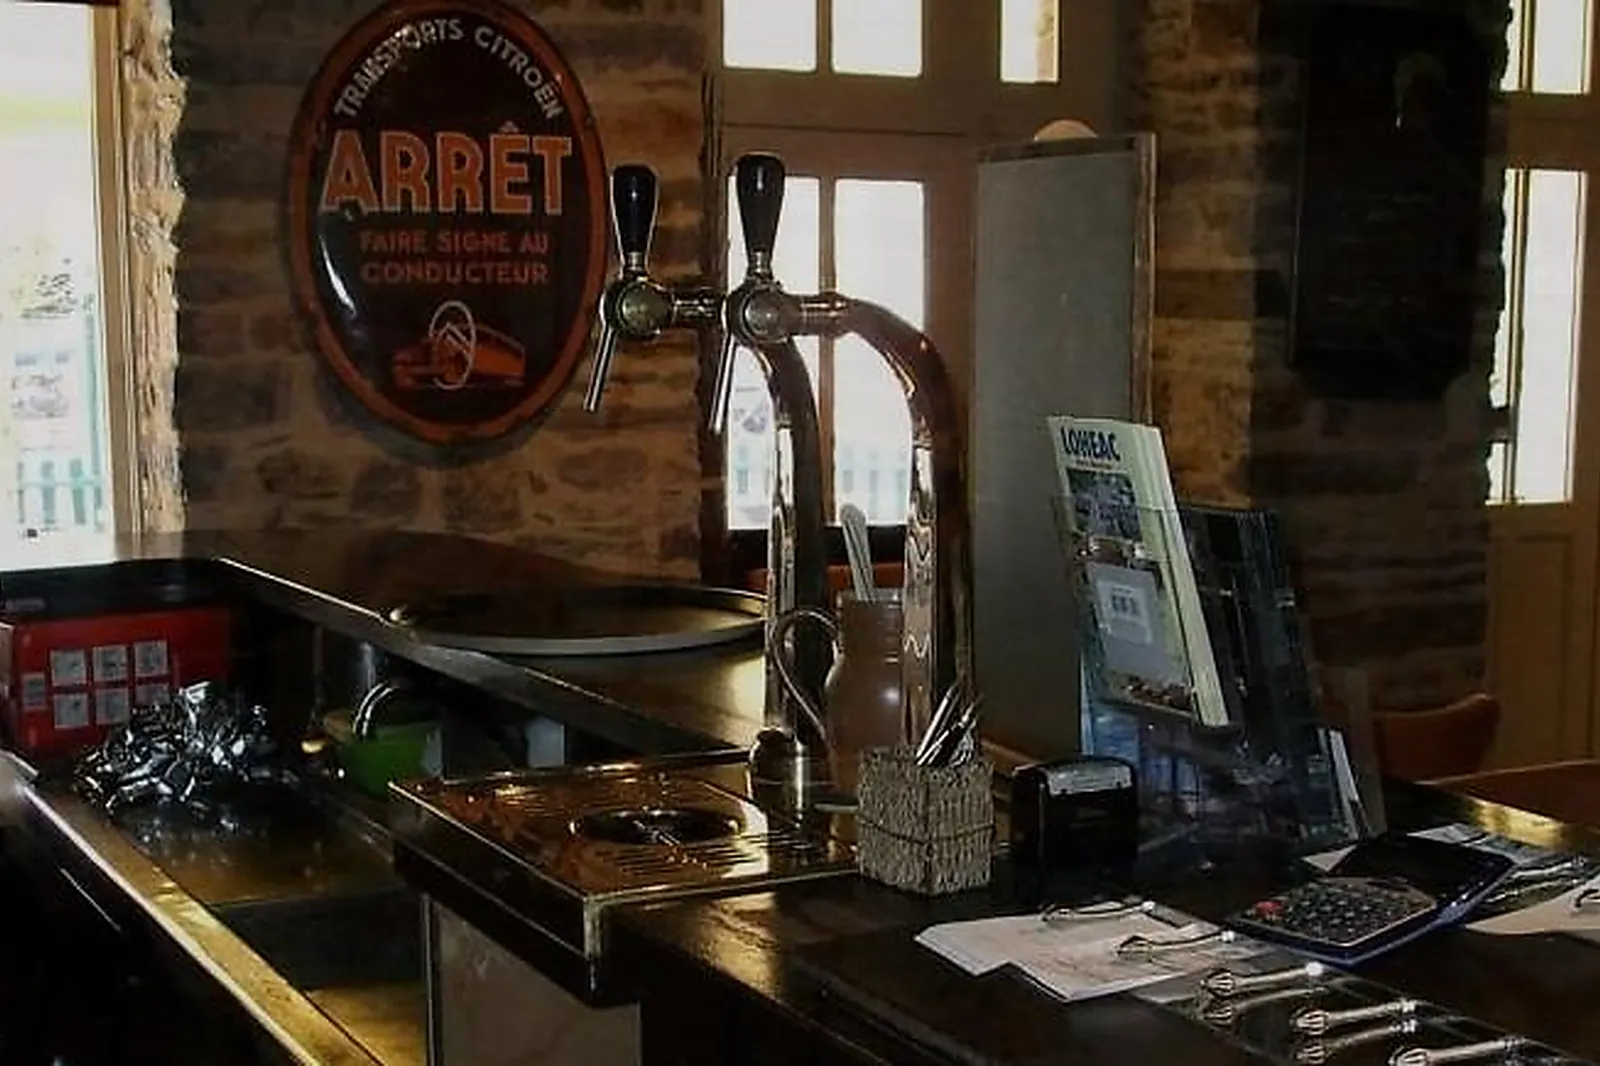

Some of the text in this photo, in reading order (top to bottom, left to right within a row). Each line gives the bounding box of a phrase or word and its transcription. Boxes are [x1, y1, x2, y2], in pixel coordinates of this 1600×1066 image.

[333, 18, 464, 118] TRANSPORTS
[319, 120, 573, 216] ARRÊT
[358, 229, 550, 256] FAIRE SIGNE AU
[359, 261, 551, 286] CONDUCTEUR
